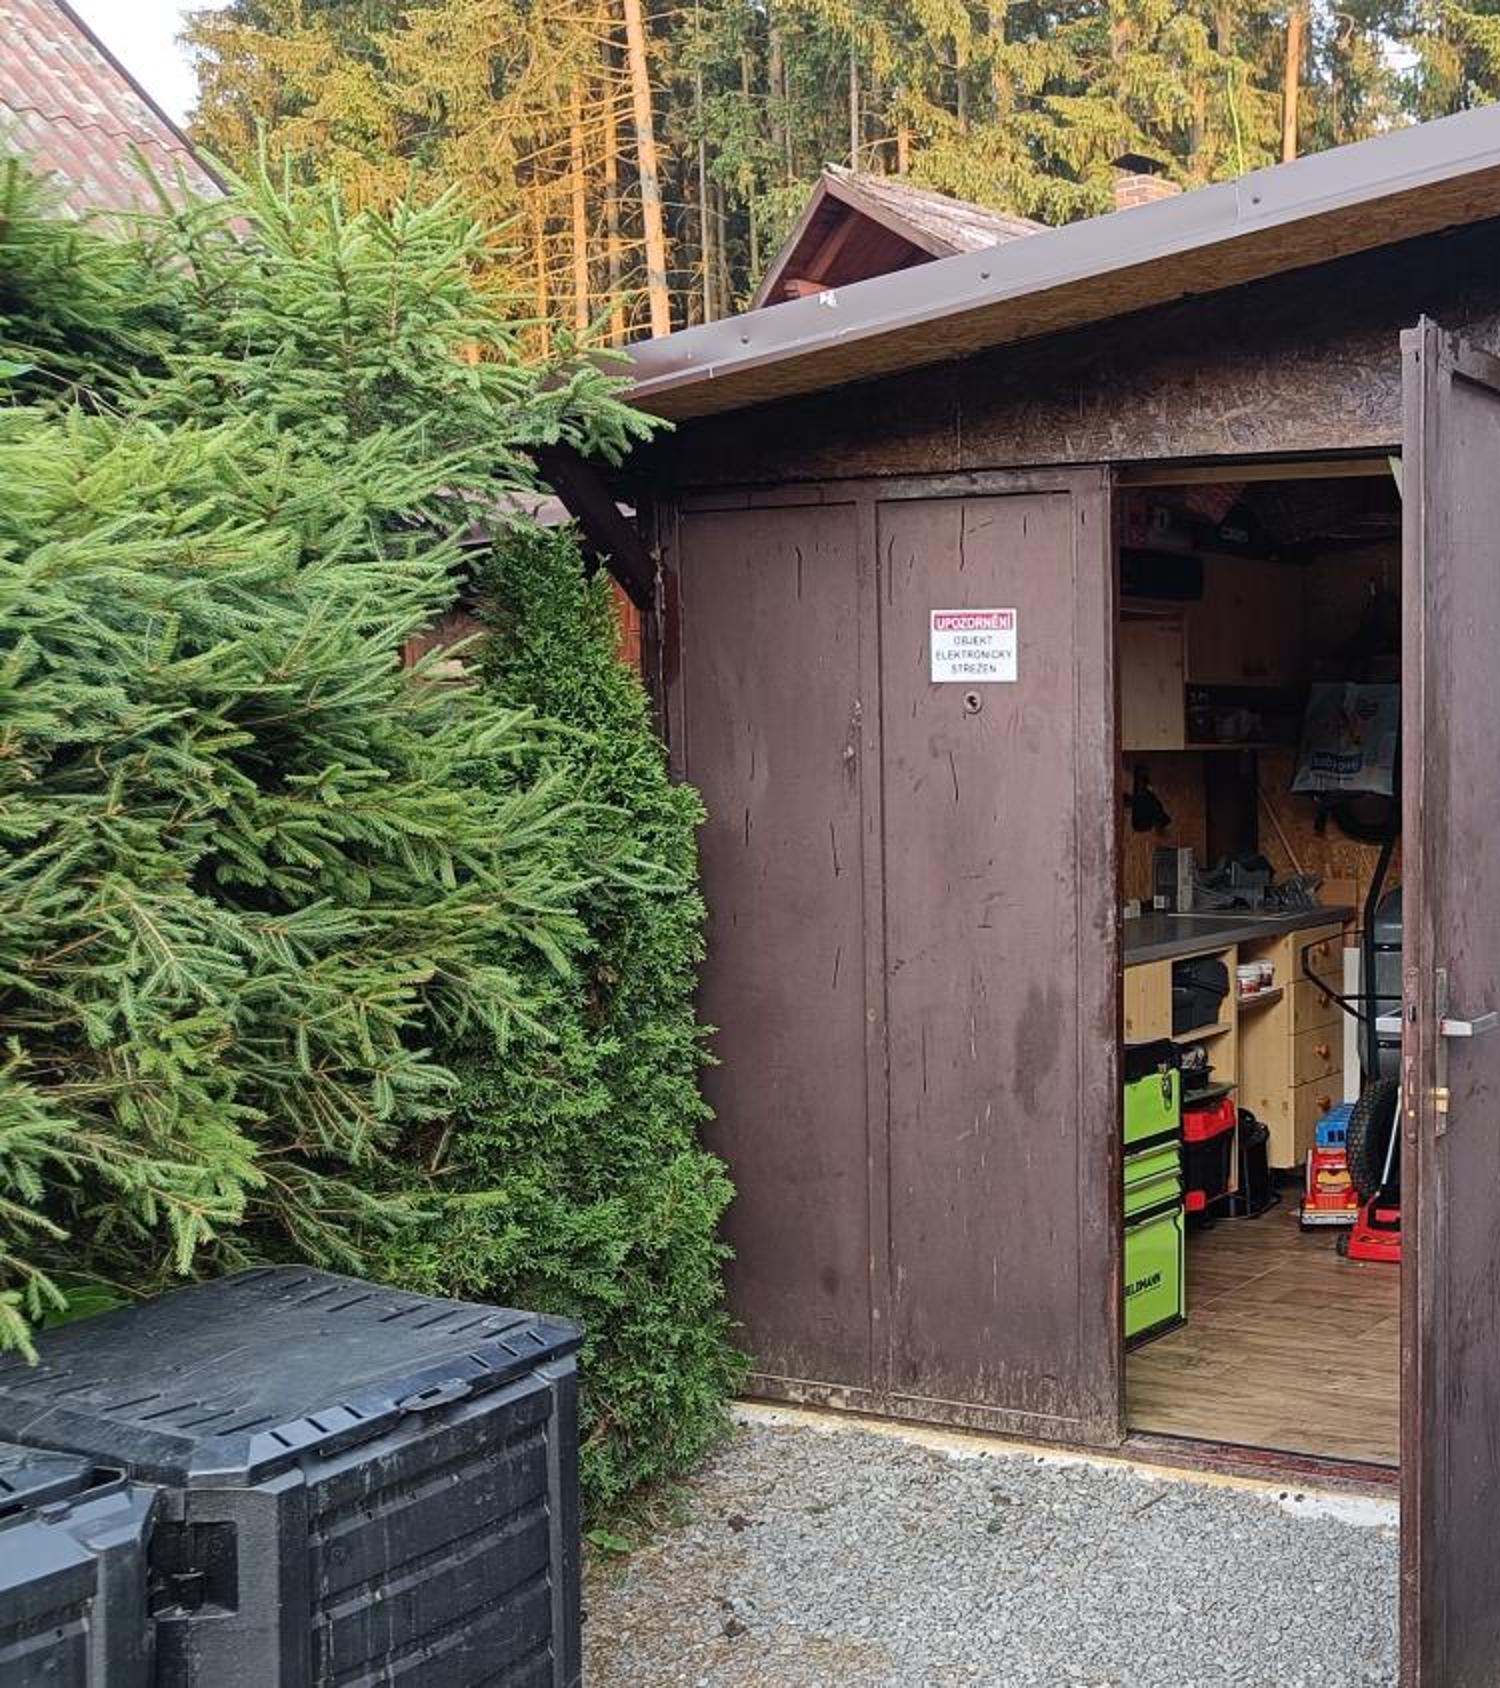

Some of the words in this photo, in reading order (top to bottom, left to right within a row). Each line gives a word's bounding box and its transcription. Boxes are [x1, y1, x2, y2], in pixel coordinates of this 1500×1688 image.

[953, 635, 993, 646] OBJEKT
[935, 649, 1012, 660] ELEKTRONICKY
[1125, 1272, 1161, 1297] ELDMANN
